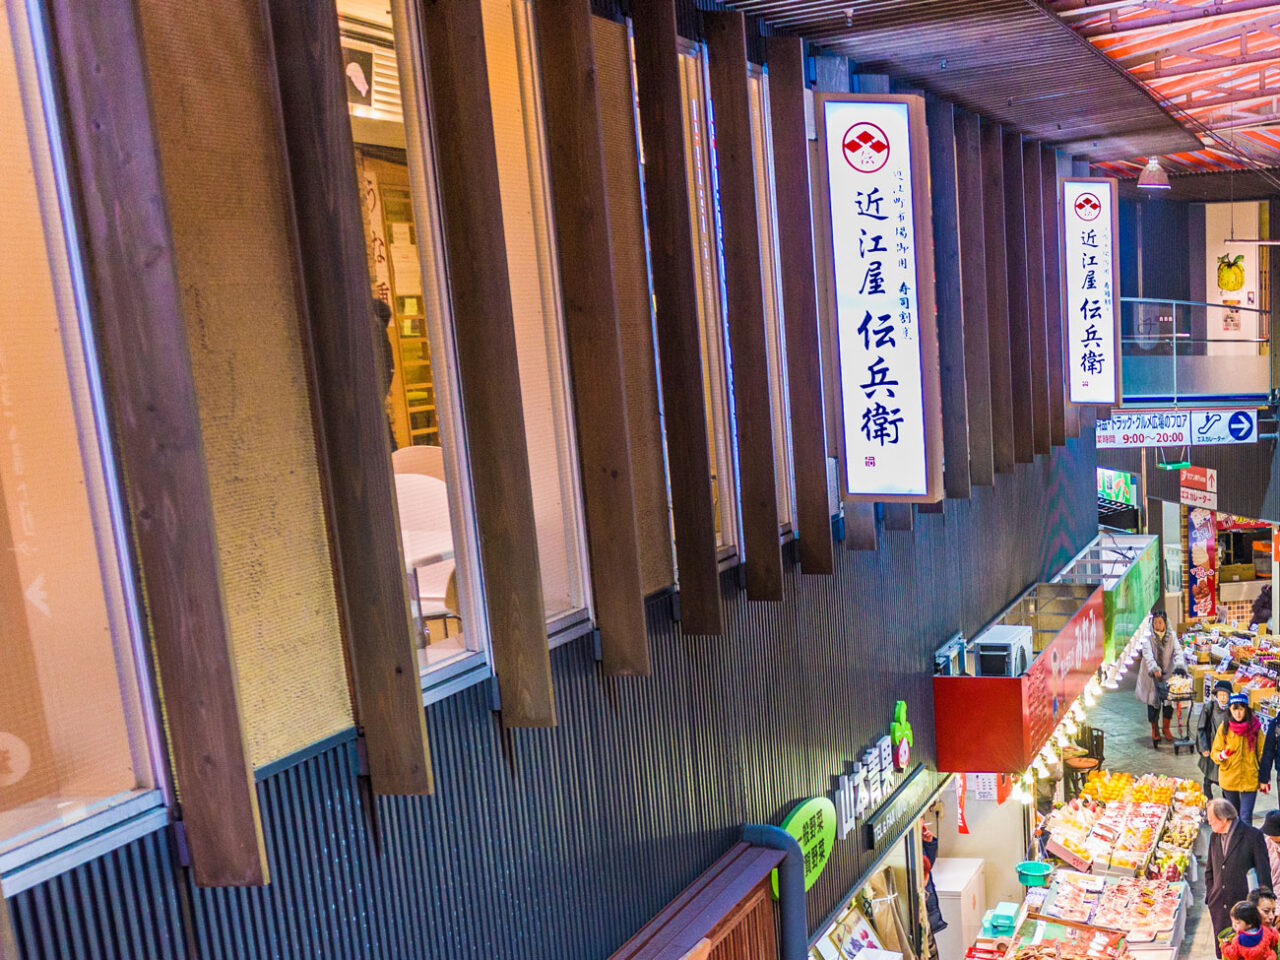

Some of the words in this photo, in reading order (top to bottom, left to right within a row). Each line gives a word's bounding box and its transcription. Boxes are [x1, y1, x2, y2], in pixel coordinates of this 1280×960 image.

[1181, 490, 1212, 503] エスカレーター
